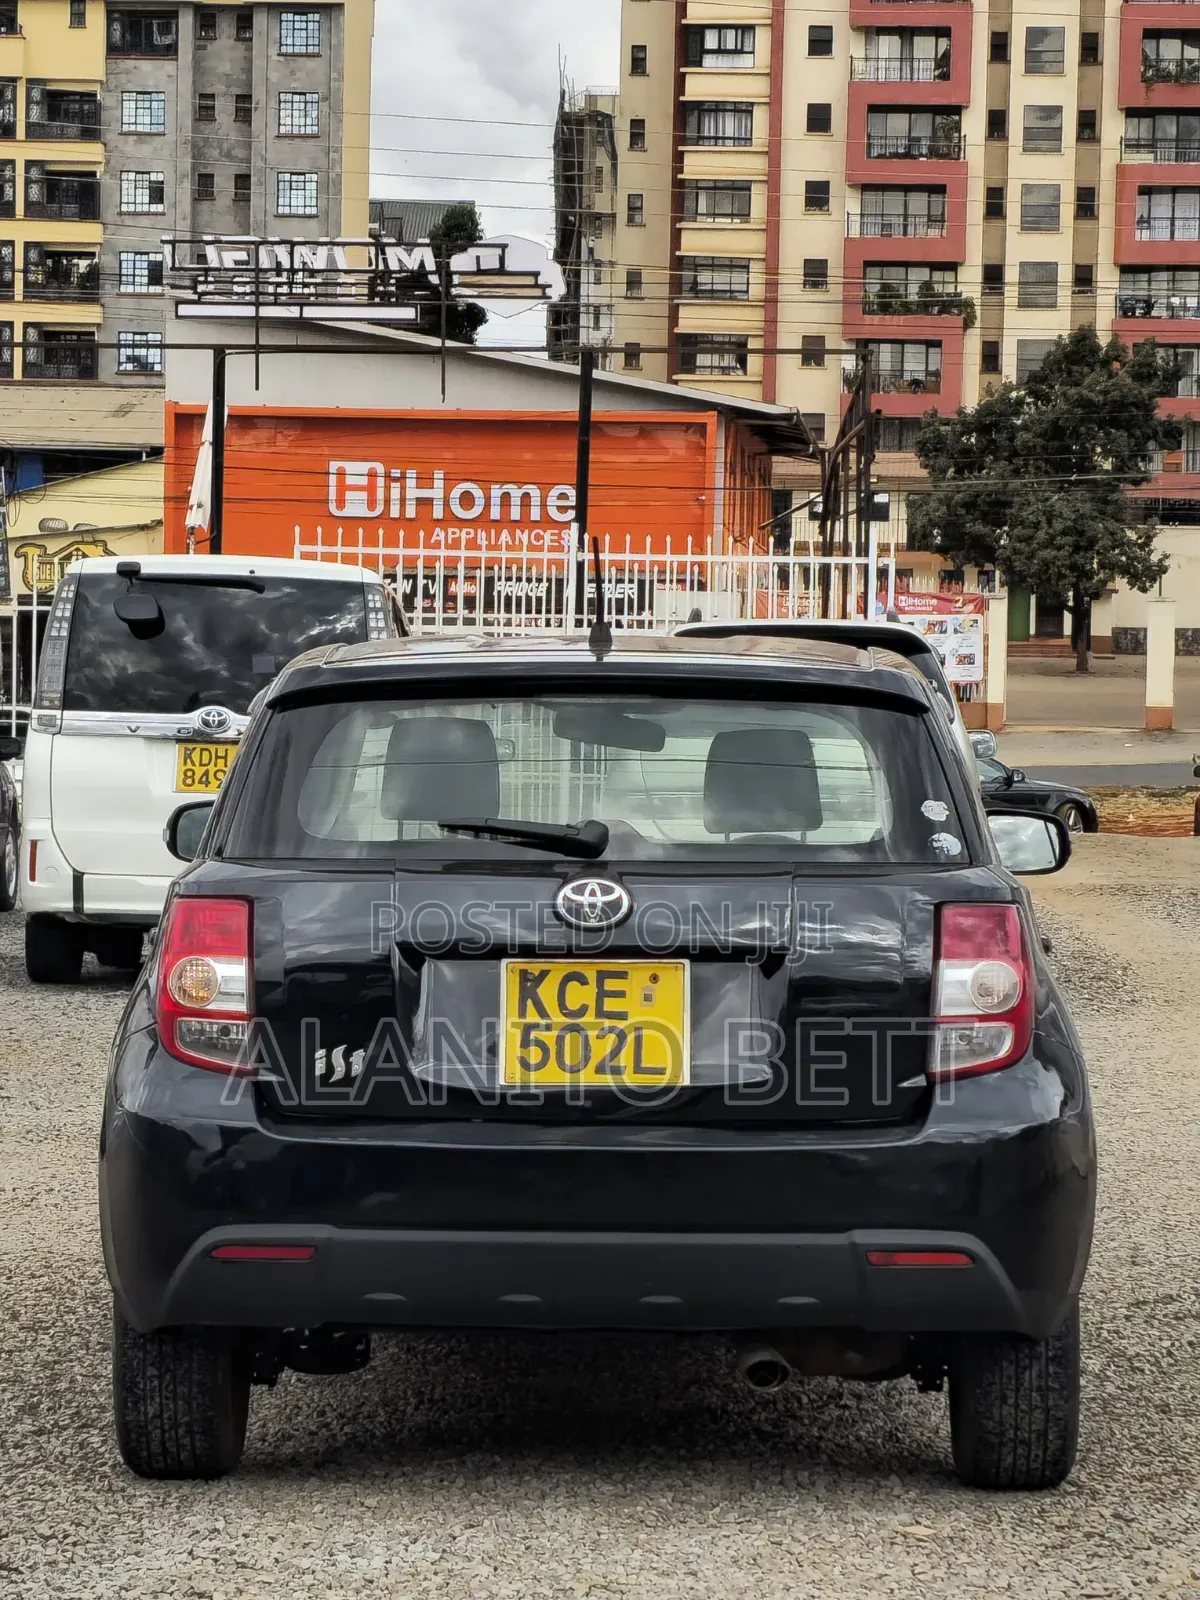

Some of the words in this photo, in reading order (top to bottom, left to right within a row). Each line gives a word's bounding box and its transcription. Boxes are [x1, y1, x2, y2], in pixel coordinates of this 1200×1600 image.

[328, 460, 576, 522] HiHome
[430, 527, 576, 548] APPLIANCES
[182, 746, 229, 768] KDH
[518, 968, 629, 1020] KCE
[517, 1022, 667, 1075] 502L
